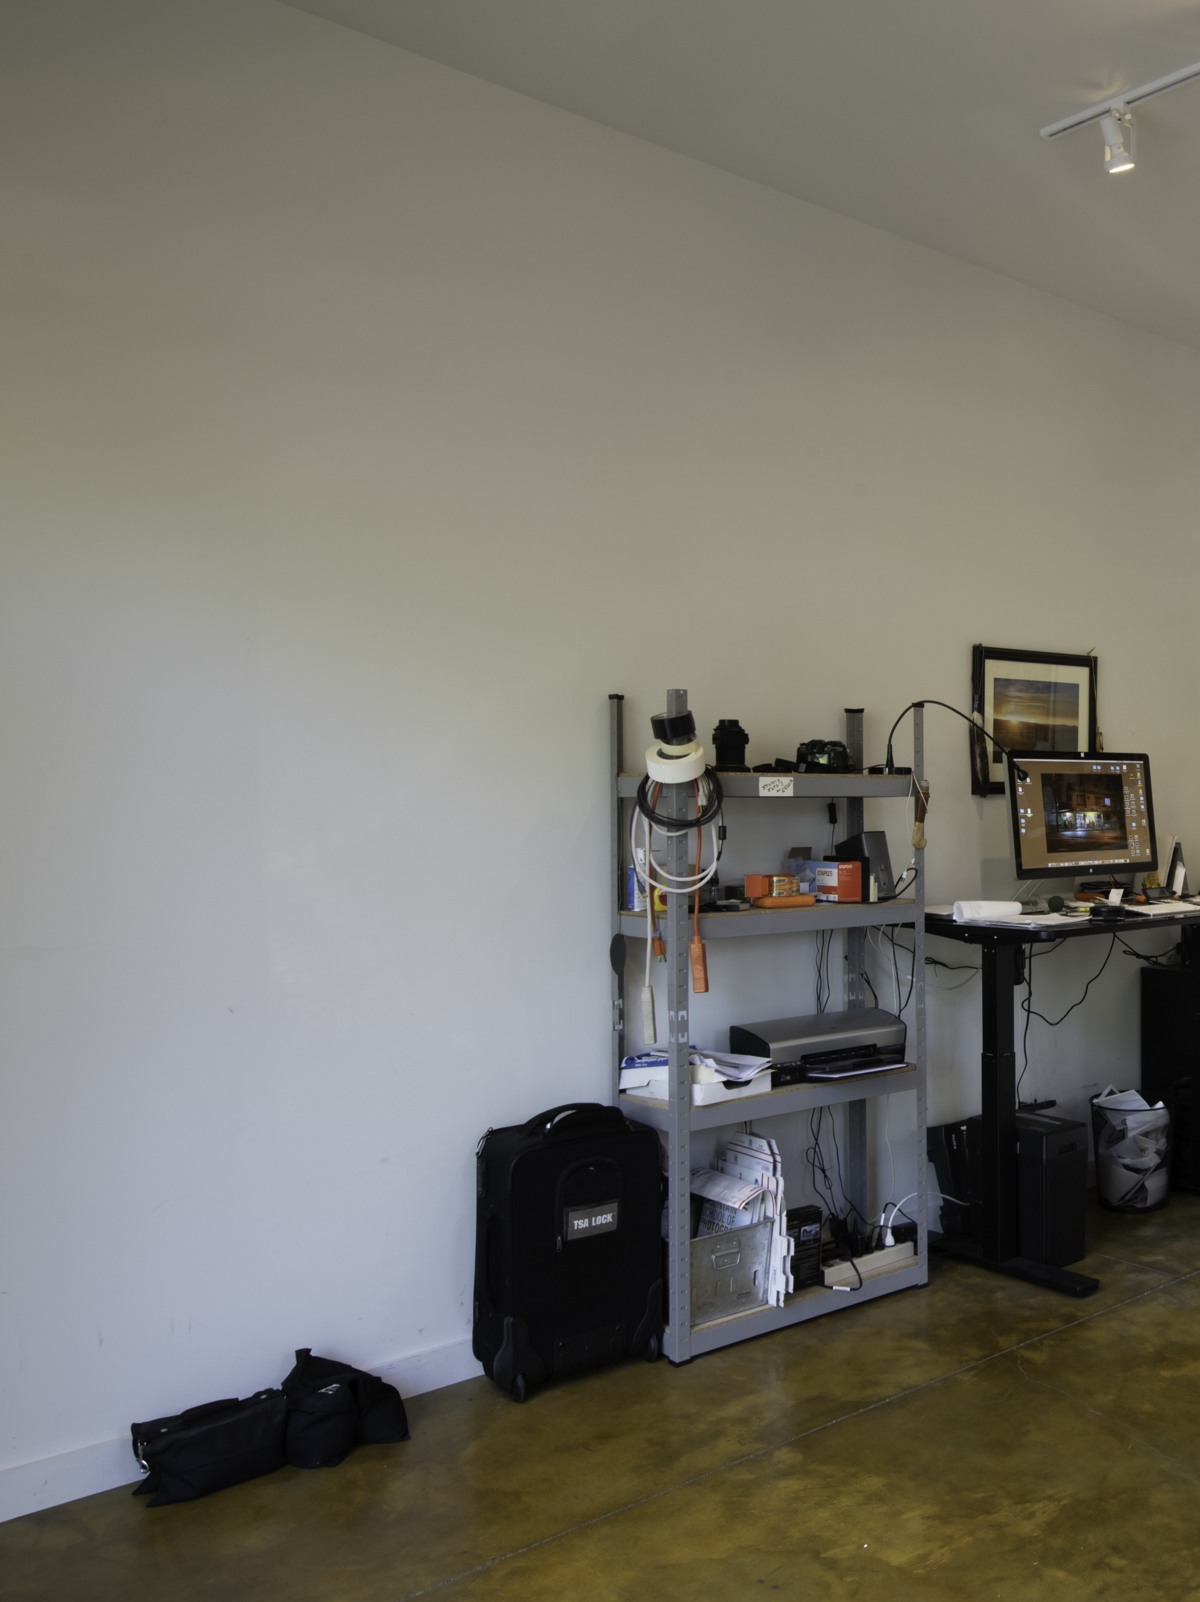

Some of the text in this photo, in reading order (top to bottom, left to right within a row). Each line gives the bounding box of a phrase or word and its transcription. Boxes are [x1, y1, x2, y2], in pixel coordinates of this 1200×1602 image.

[573, 1212, 613, 1230] TSA LOCK
[726, 1214, 736, 1226] OF
